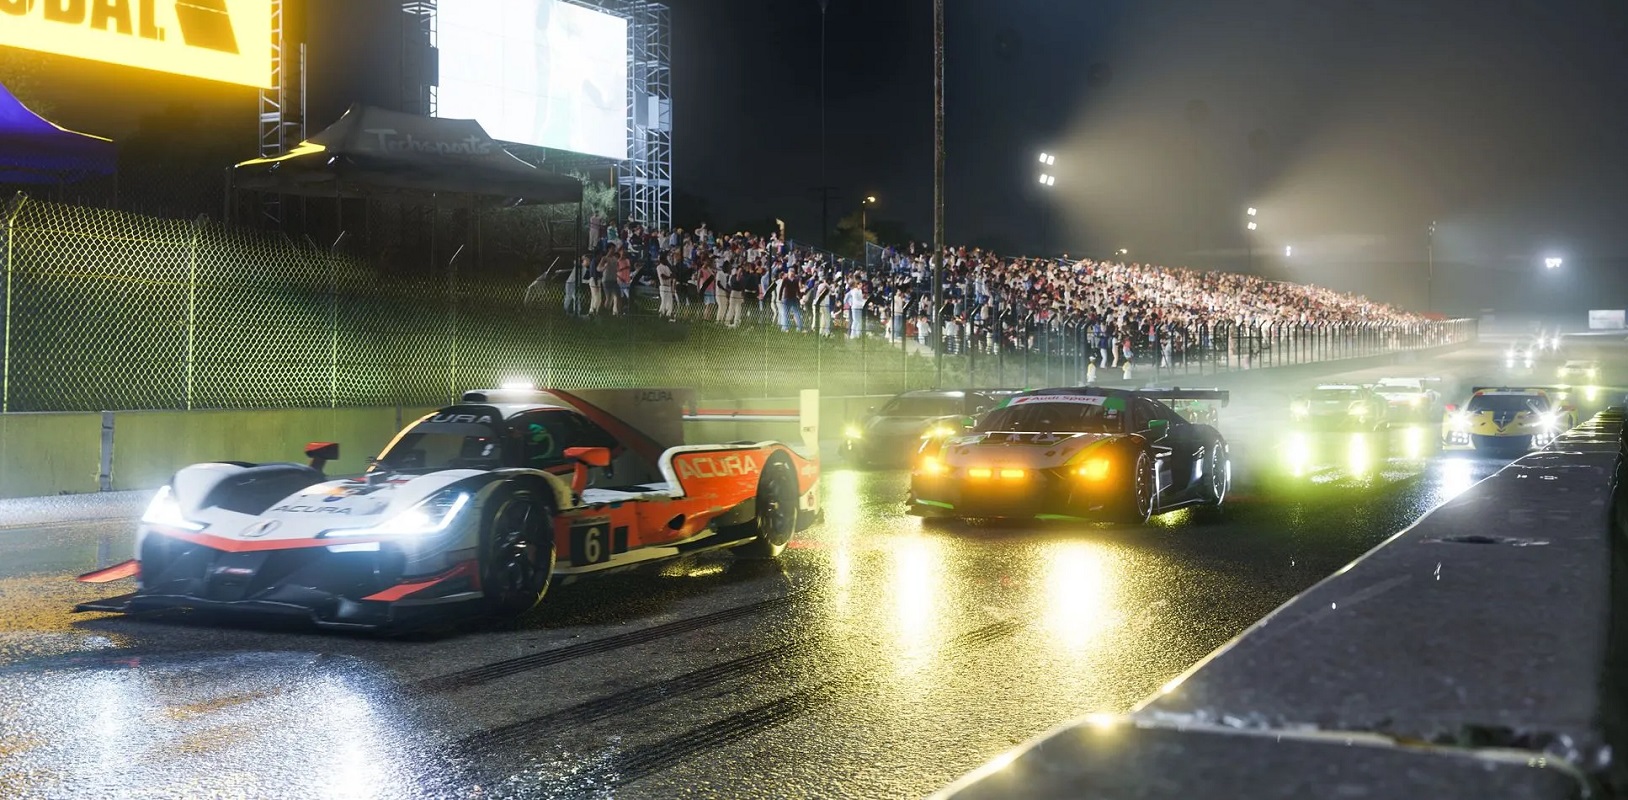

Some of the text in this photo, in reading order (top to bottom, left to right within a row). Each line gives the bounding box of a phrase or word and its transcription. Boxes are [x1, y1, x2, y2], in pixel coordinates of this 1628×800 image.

[0, 0, 165, 41] AL
[427, 413, 492, 423] URA
[677, 454, 759, 479] ACURA
[271, 505, 352, 514] ACURA
[585, 527, 600, 563] 6
